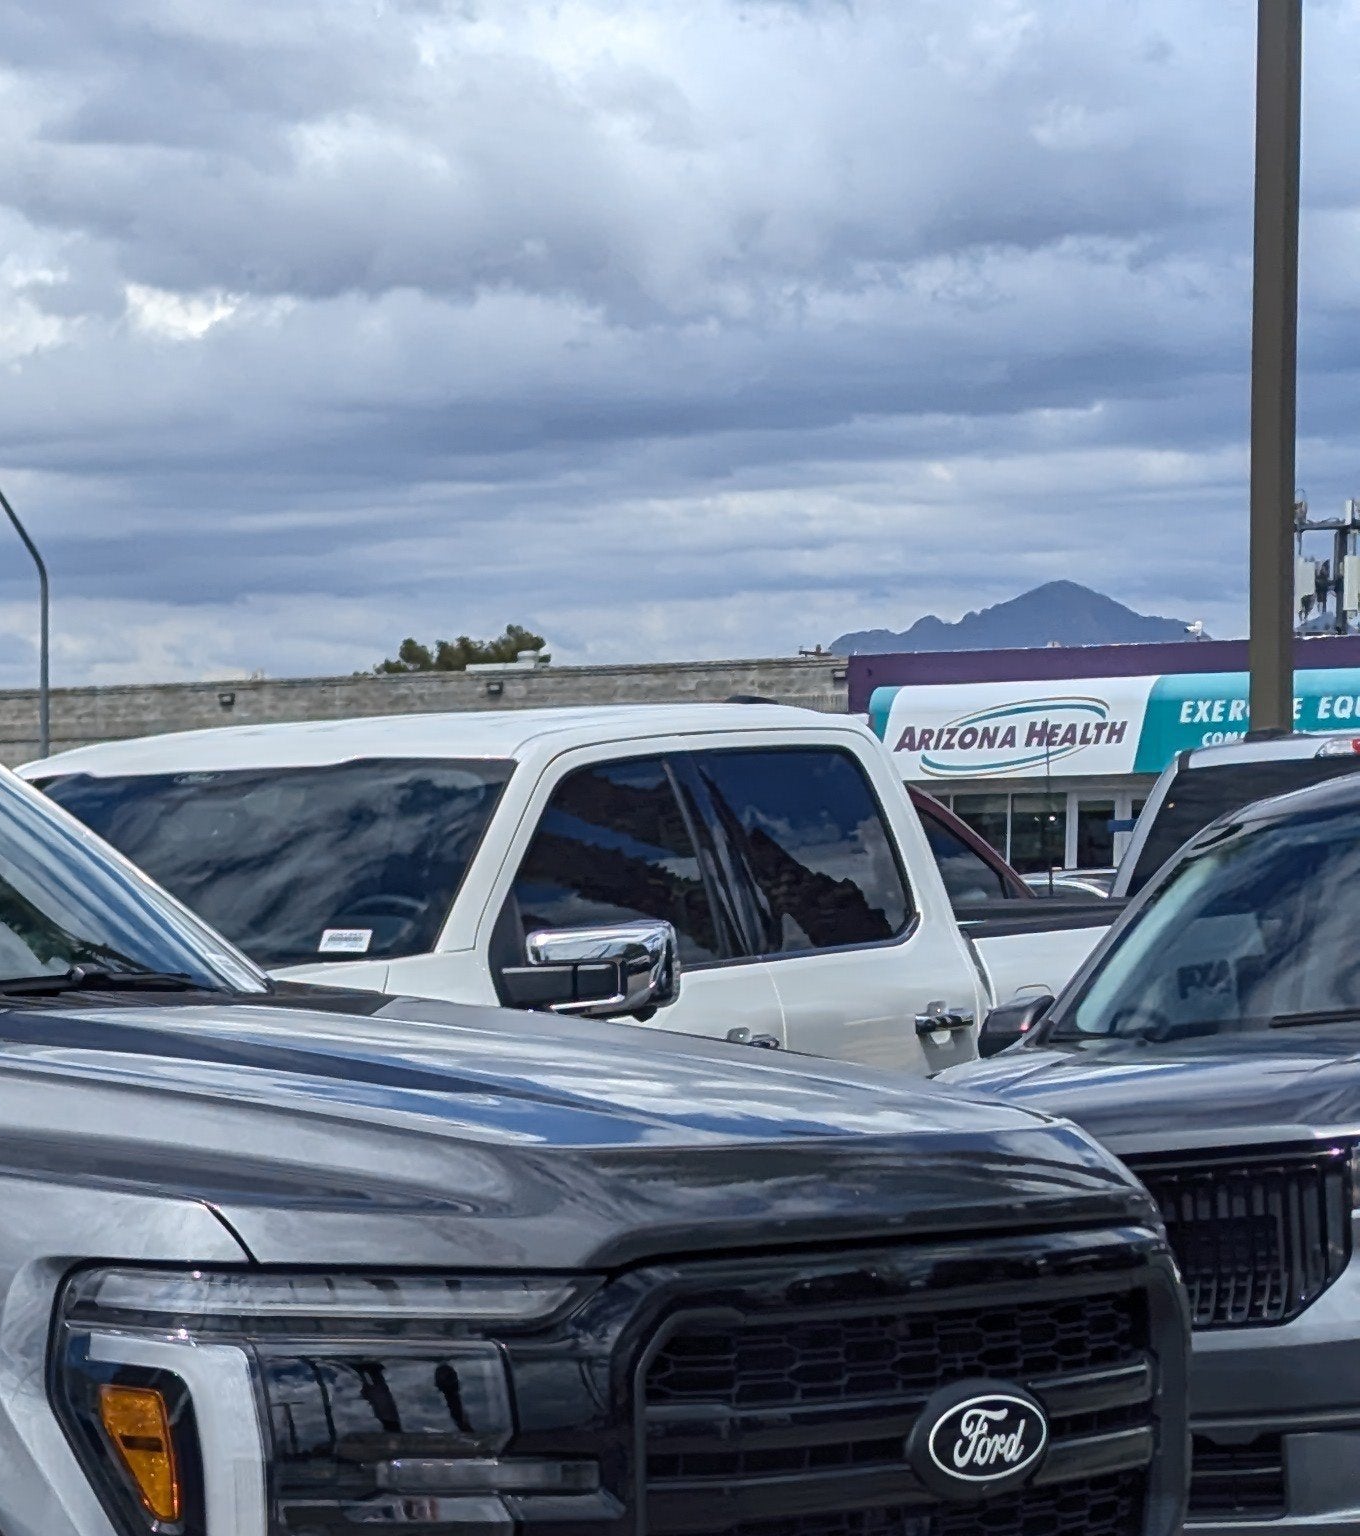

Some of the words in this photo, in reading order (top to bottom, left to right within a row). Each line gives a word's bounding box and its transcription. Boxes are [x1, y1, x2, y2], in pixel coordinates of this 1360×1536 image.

[893, 725, 1017, 753] ARIZONA
[1024, 719, 1129, 748] HEALTH
[953, 1407, 1027, 1468] Ford
